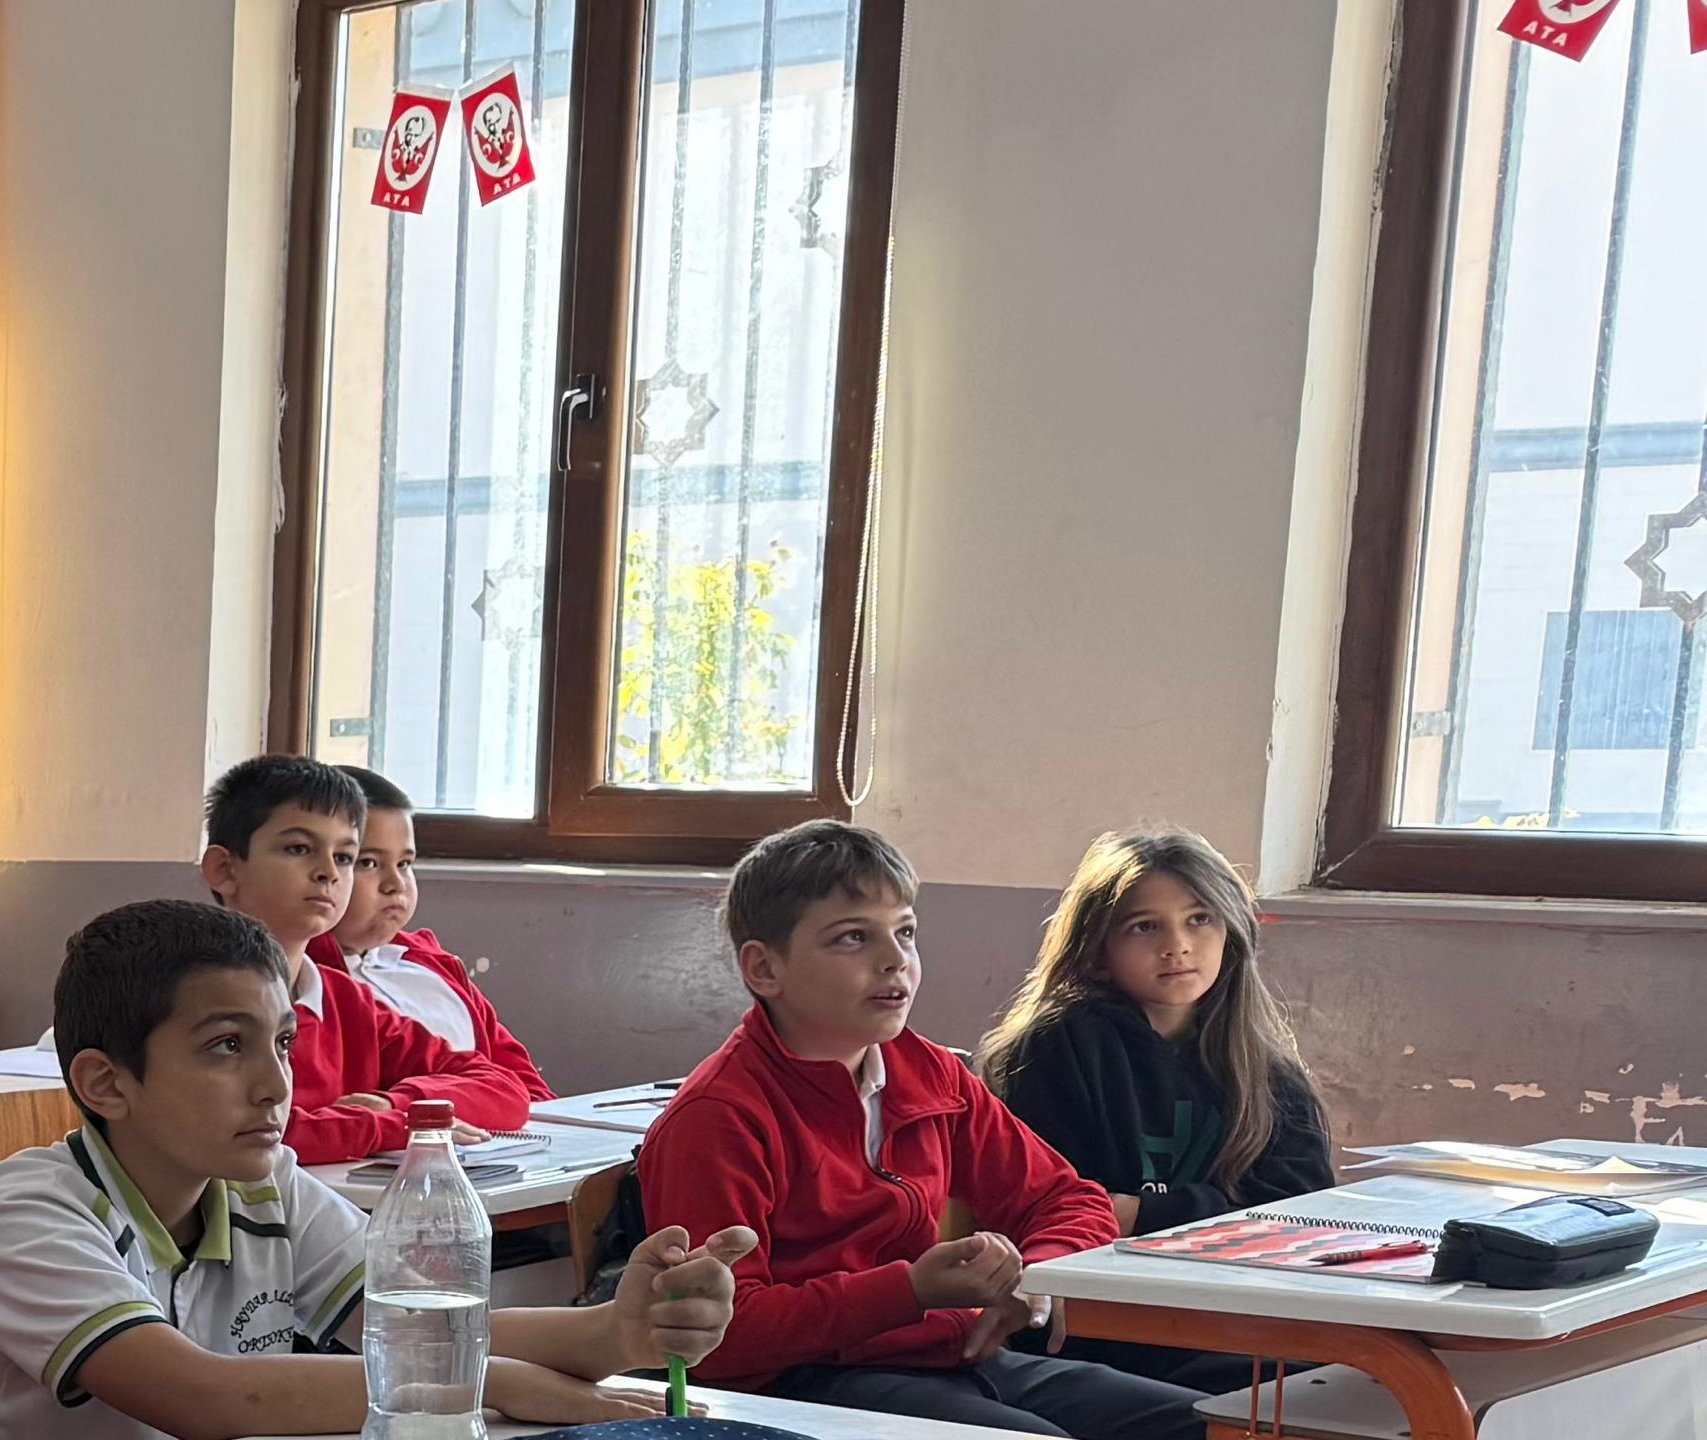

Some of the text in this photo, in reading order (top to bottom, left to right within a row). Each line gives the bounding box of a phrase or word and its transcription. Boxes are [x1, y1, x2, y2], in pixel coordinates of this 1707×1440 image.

[1523, 20, 1570, 48] ATA
[492, 172, 523, 196] ATA
[382, 191, 411, 208] ATA
